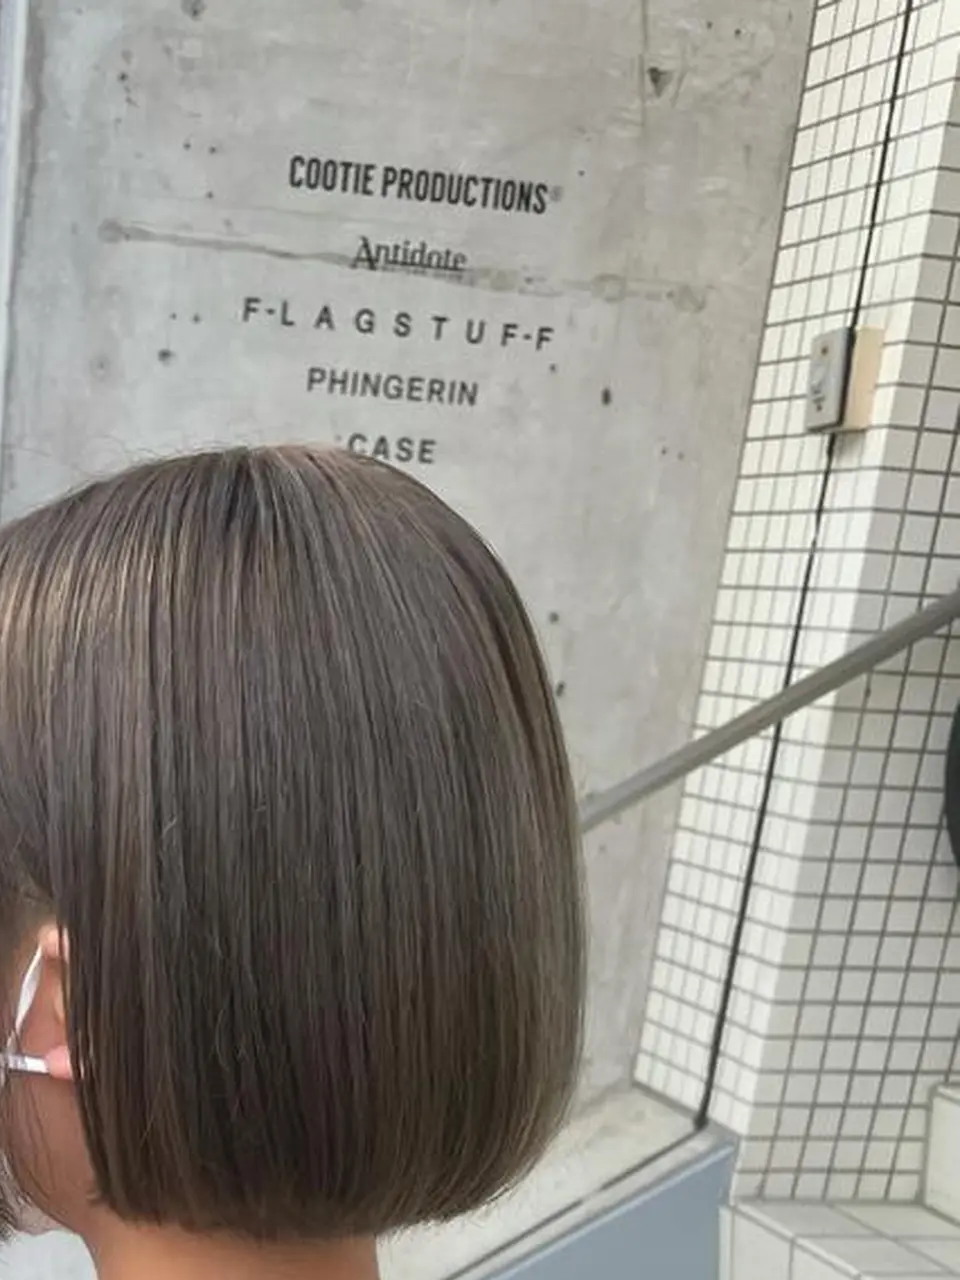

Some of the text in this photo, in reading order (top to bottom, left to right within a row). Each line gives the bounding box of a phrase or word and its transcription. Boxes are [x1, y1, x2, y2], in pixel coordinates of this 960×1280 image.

[289, 154, 550, 215] COOTIE PRODUCTIONS
[348, 234, 468, 272] Antidote
[306, 366, 480, 407] PHINGERIN
[347, 431, 437, 465] CASE
